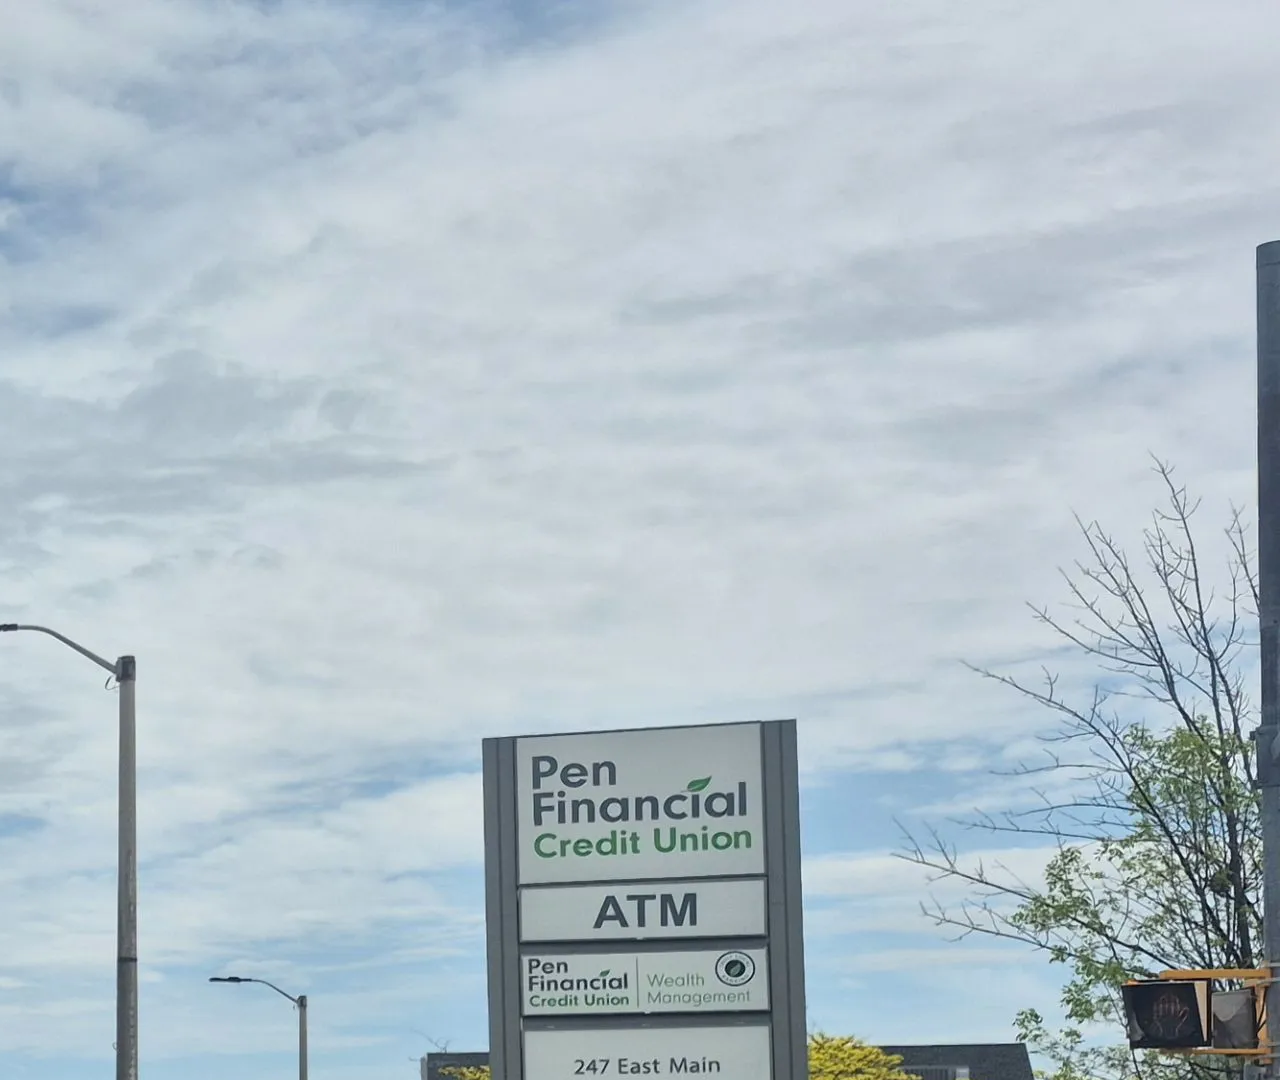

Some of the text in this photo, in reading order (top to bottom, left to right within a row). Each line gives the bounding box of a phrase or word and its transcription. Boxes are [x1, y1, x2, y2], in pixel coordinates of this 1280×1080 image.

[531, 755, 617, 790] Pen
[532, 779, 748, 826] Financial
[533, 825, 752, 859] Credit Union
[592, 892, 698, 929] ATM
[528, 959, 568, 975] Pen
[528, 972, 628, 992] Financial
[646, 973, 705, 988] Wealth
[529, 993, 629, 1008] Credit Union
[646, 990, 750, 1008] Management
[573, 1057, 721, 1076] 247 East Main
